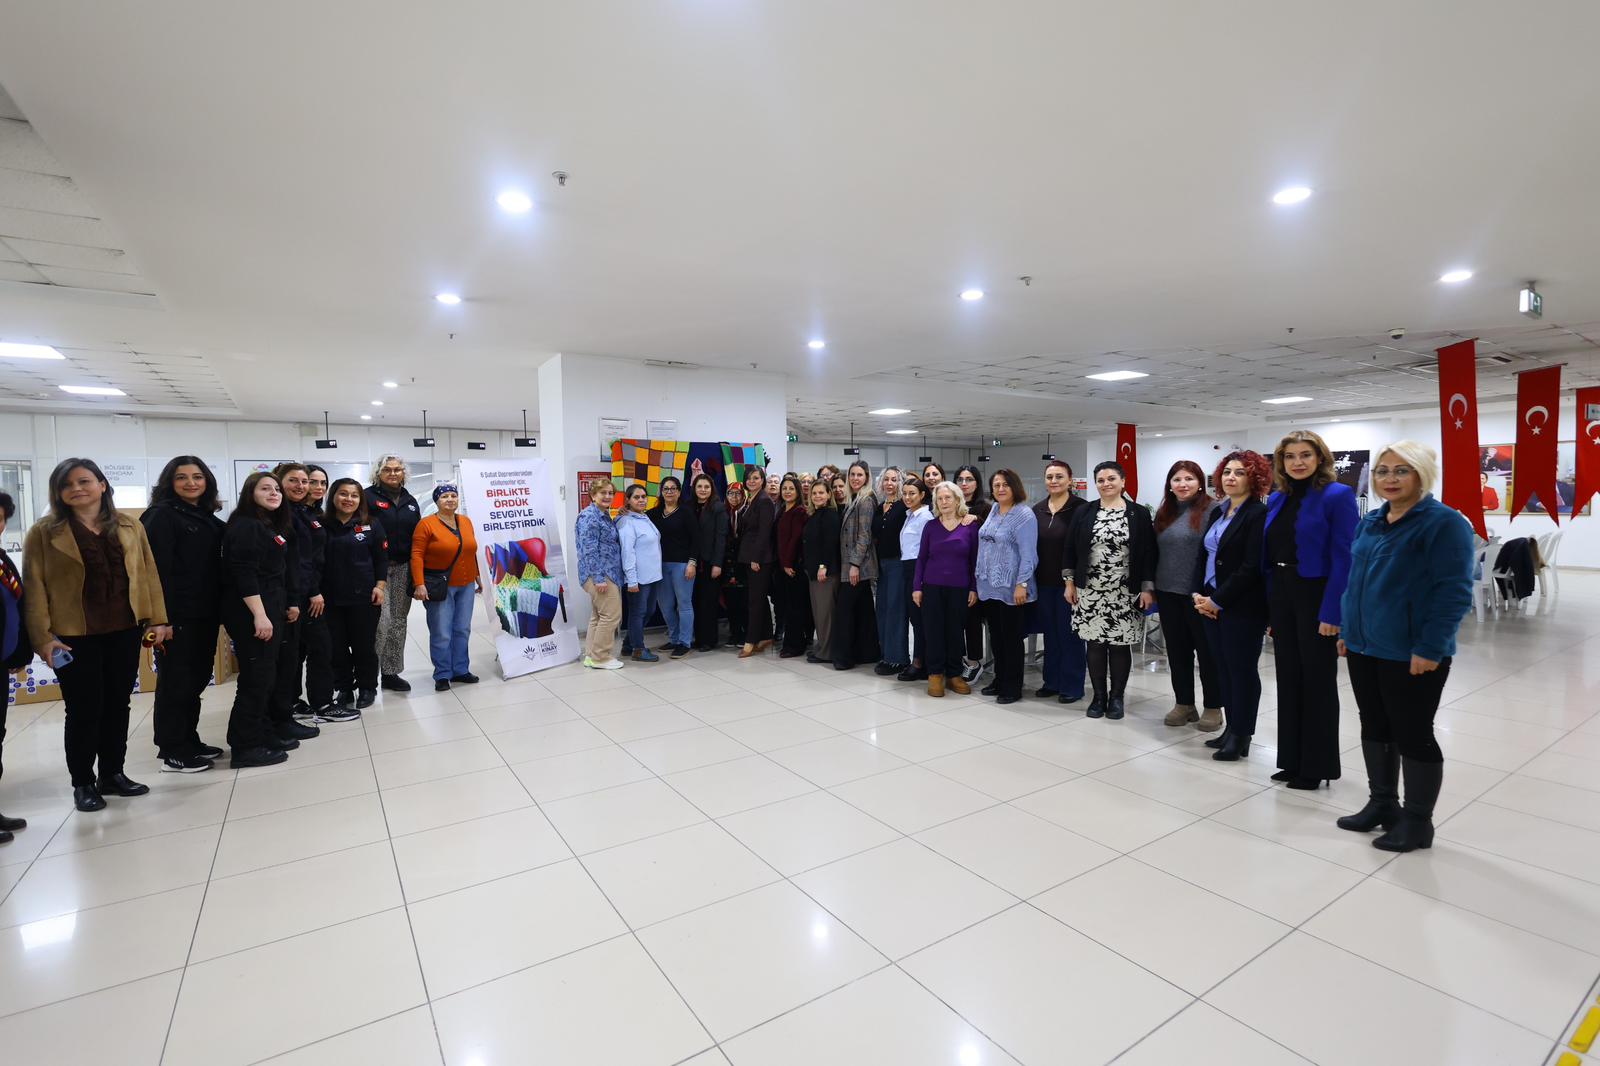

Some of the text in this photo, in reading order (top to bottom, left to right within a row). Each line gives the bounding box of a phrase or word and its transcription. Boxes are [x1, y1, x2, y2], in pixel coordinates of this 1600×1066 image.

[486, 487, 531, 498] BİRLİKTE
[494, 497, 529, 508] ÖRDÜK
[490, 508, 534, 519] SEVGİYLE
[483, 517, 546, 531] BİRLEŞTİRDİK
